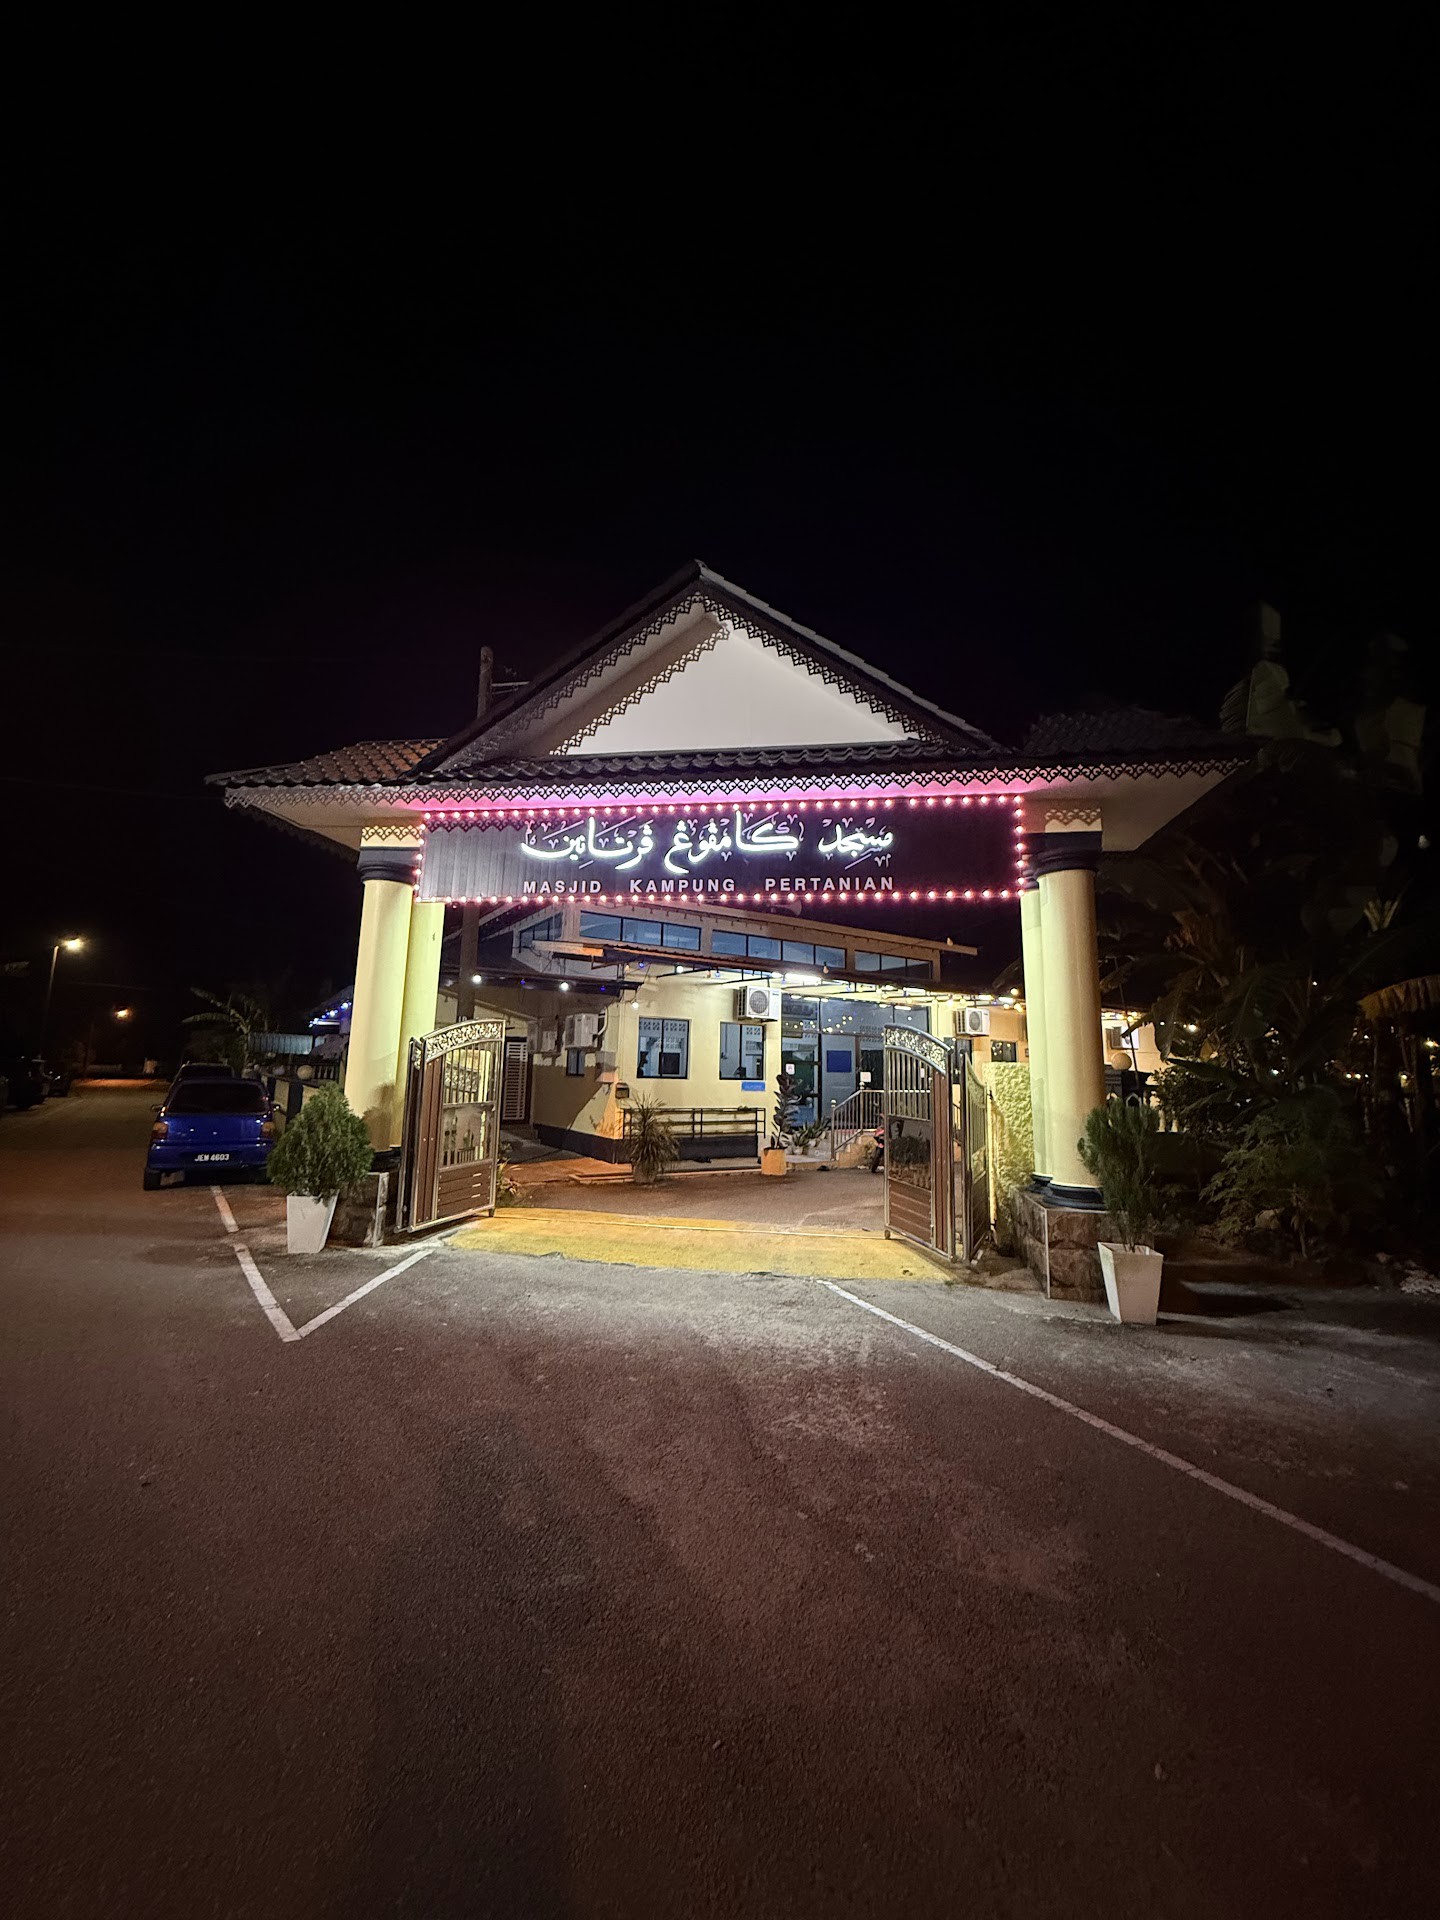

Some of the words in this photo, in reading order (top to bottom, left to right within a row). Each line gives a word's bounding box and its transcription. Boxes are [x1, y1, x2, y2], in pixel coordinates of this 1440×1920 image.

[817, 817, 894, 870] مسجد
[523, 880, 602, 894] MASJID
[629, 878, 735, 893] KAMPUNG
[765, 876, 893, 892] PERTANIAN
